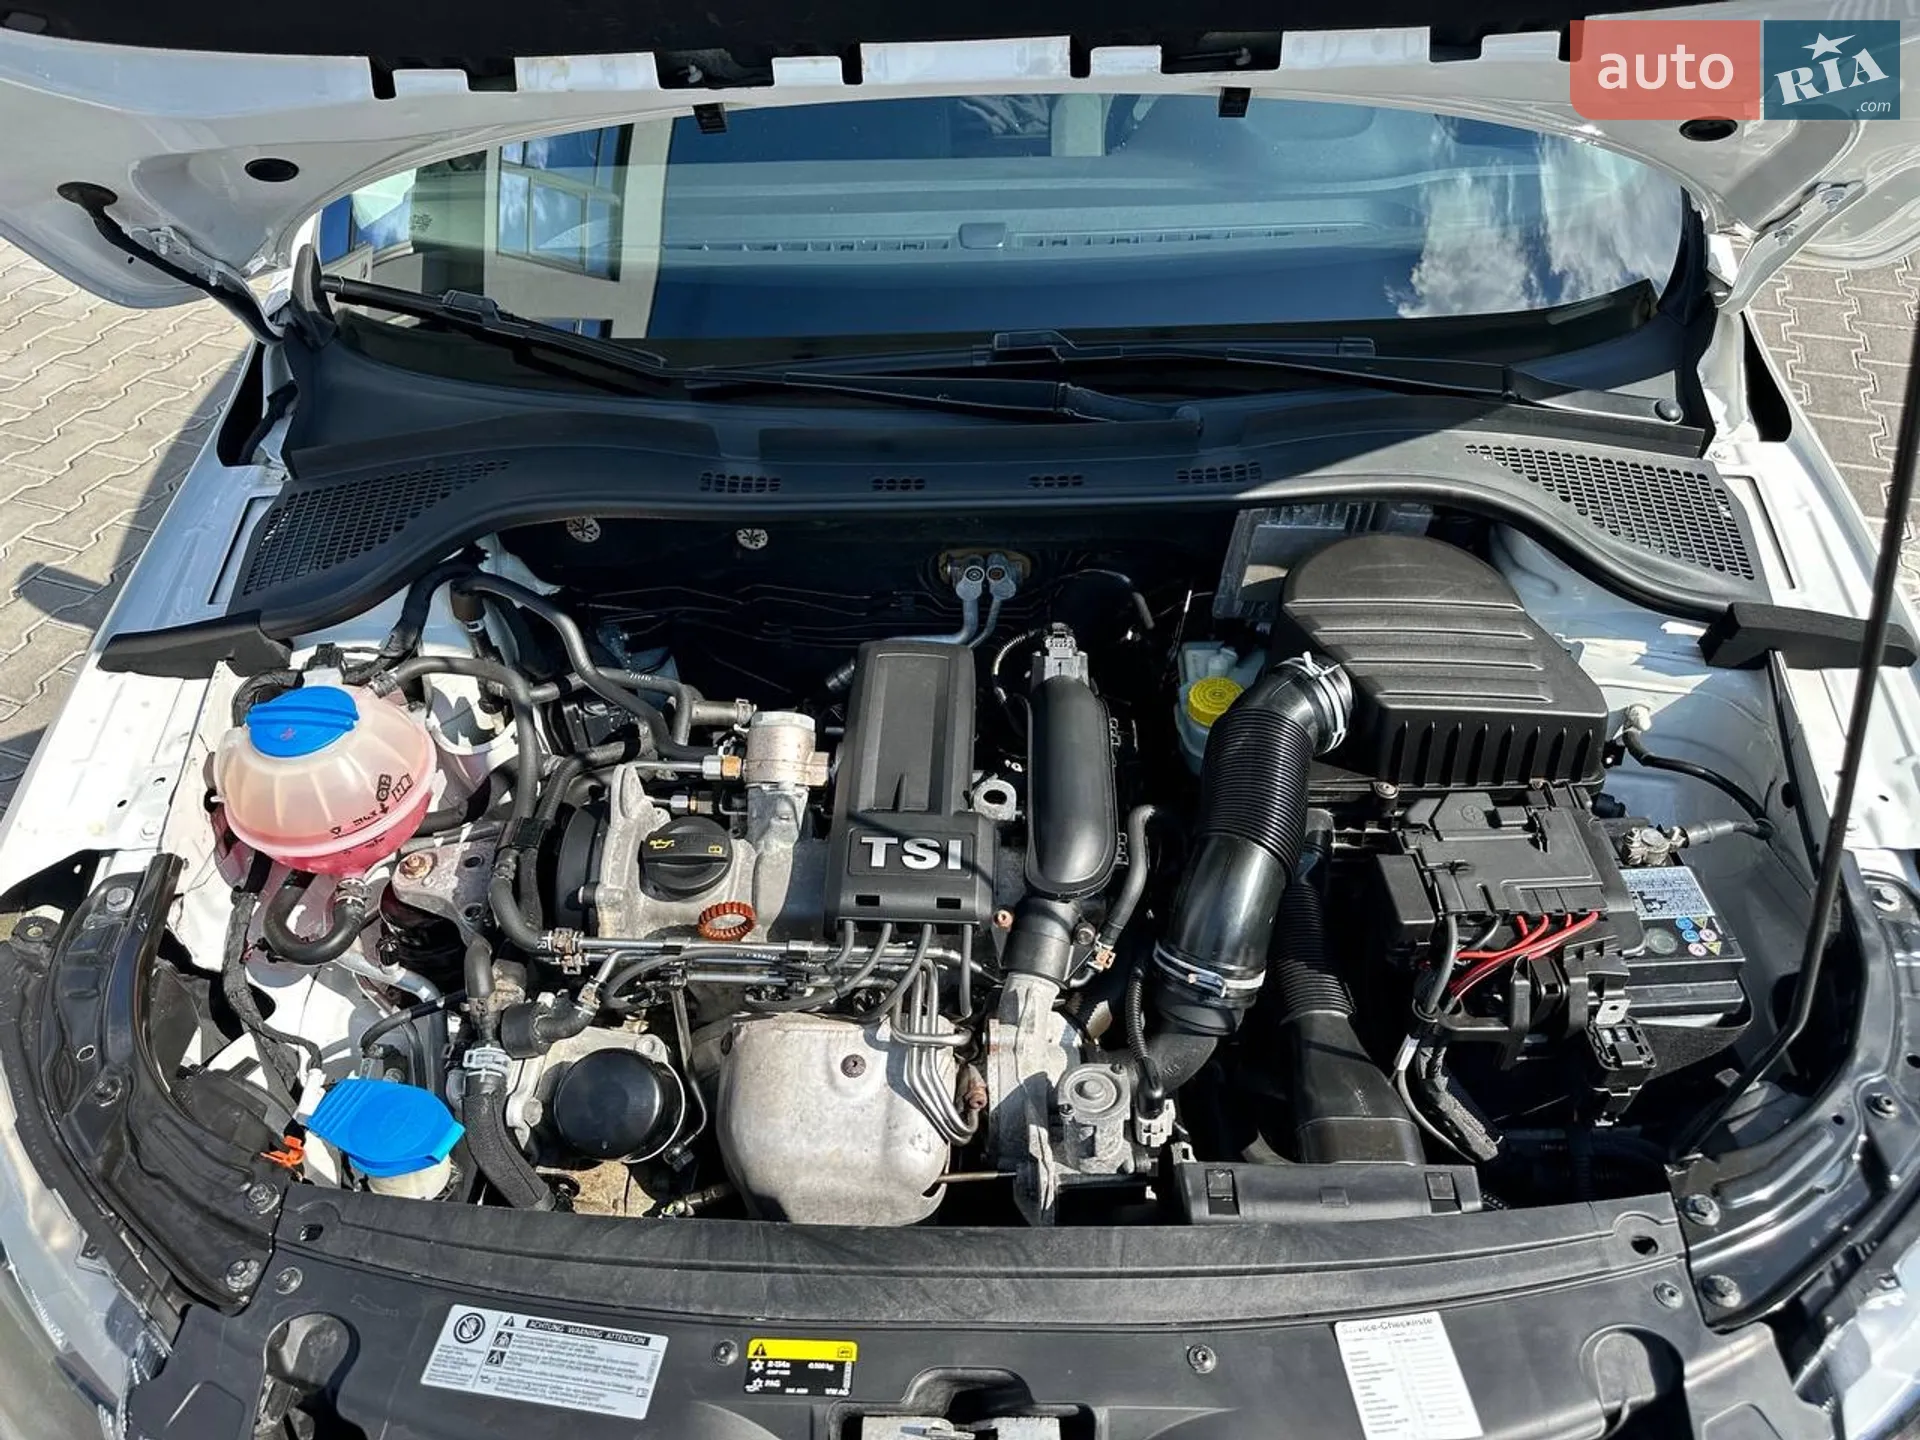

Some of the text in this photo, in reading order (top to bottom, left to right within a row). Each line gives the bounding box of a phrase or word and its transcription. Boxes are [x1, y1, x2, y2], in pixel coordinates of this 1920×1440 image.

[860, 836, 963, 870] TSI
[528, 1320, 647, 1344] ACHTUNG WARNING ATTENTION
